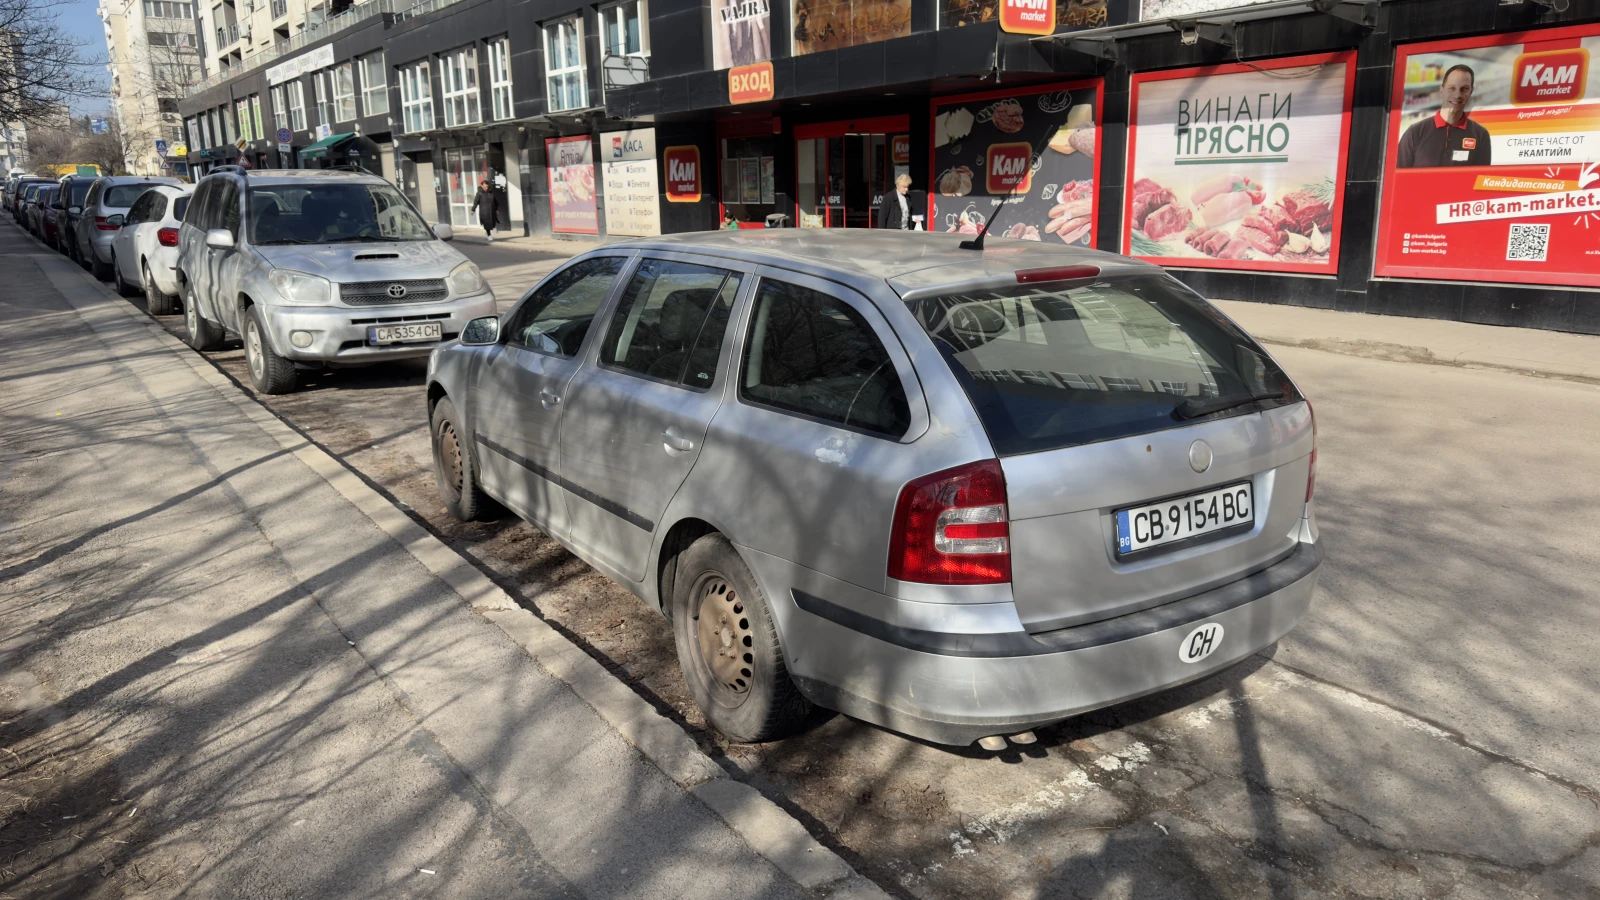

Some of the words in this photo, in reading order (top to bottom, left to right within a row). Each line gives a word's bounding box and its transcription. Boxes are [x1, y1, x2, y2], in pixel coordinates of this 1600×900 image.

[721, 0, 769, 22] VAJRA
[1020, 10, 1046, 22] market
[731, 70, 771, 93] ВХОД
[1536, 85, 1572, 96] market
[1178, 91, 1292, 127] ВИНАГИ
[1517, 108, 1545, 119] Купувай
[1546, 106, 1572, 116] мъдро!
[1176, 122, 1290, 156] ПРЯСНО
[1507, 137, 1545, 147] СТАНЕТЕ
[1546, 136, 1570, 145] ЧАСТ
[1572, 135, 1585, 144] ОТ
[624, 139, 644, 152] КАСА
[1518, 147, 1572, 157] #КАМТИЙМ
[630, 165, 646, 173] Билети
[631, 180, 650, 188] Винетки
[678, 182, 695, 191] market
[1482, 178, 1565, 190] Кандидатствай
[632, 194, 654, 203] Интернет
[1449, 193, 1600, 218] HR@kam-market.
[633, 207, 653, 218] Телефон
[1410, 247, 1447, 255] kam-market.bg
[378, 329, 393, 340] CA
[394, 326, 422, 339] 5354
[424, 325, 439, 337] CH
[1134, 509, 1164, 543] CB
[1168, 496, 1219, 536] 9154
[1223, 489, 1249, 522] BC
[1120, 537, 1130, 548] BG
[1188, 627, 1216, 659] CH
